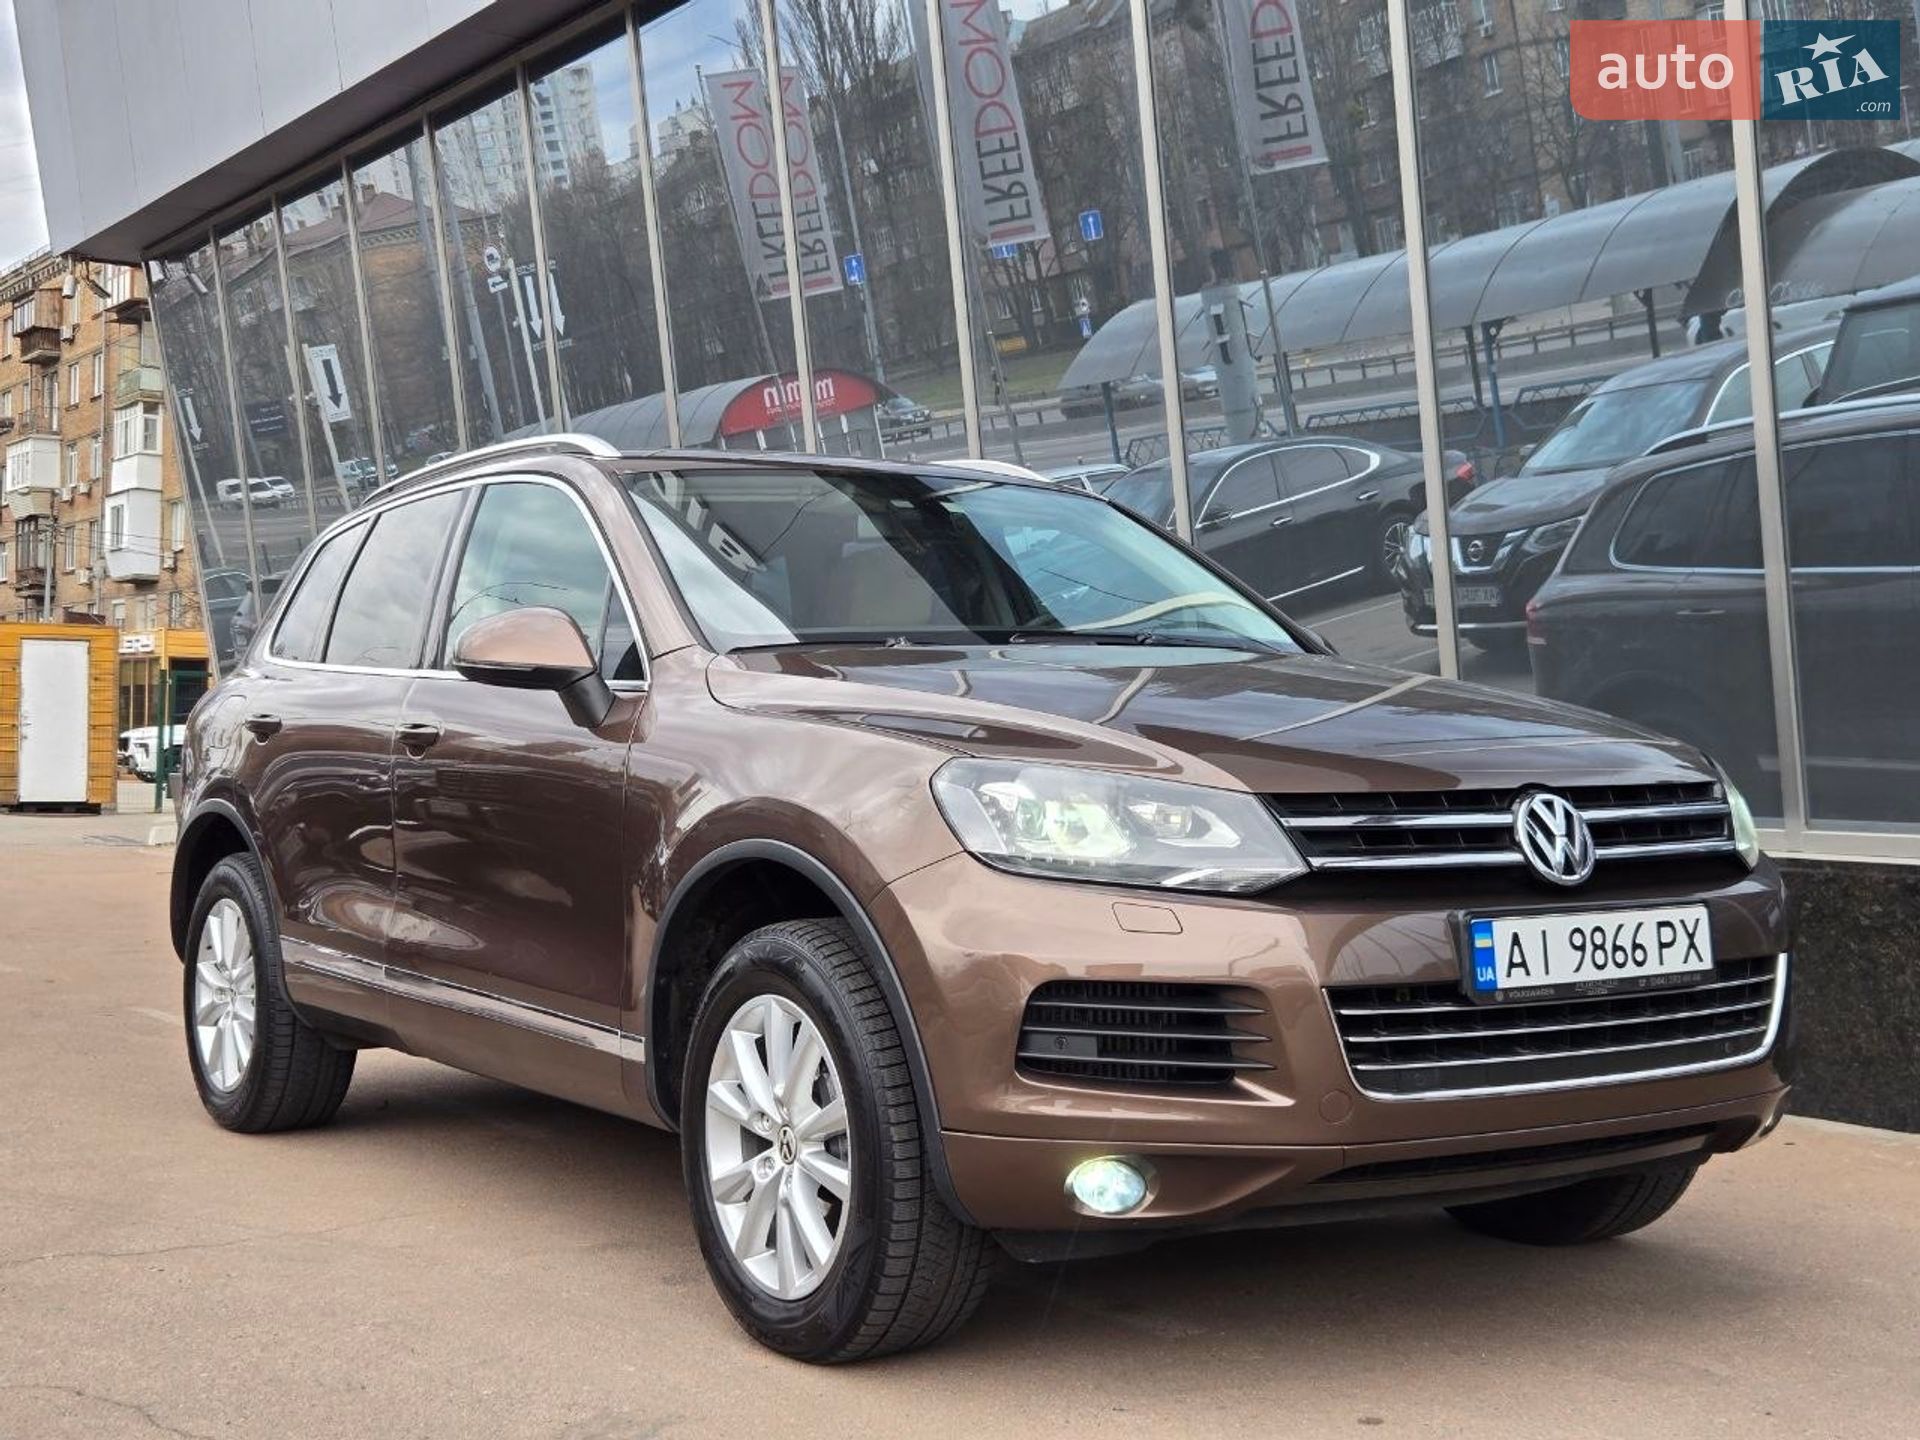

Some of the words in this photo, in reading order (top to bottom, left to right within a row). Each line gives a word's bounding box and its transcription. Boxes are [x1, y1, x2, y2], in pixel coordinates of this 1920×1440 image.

[1506, 930, 1550, 977] AI
[1568, 921, 1648, 974] 9866
[1656, 918, 1703, 966] PX
[1477, 966, 1495, 982] UA
